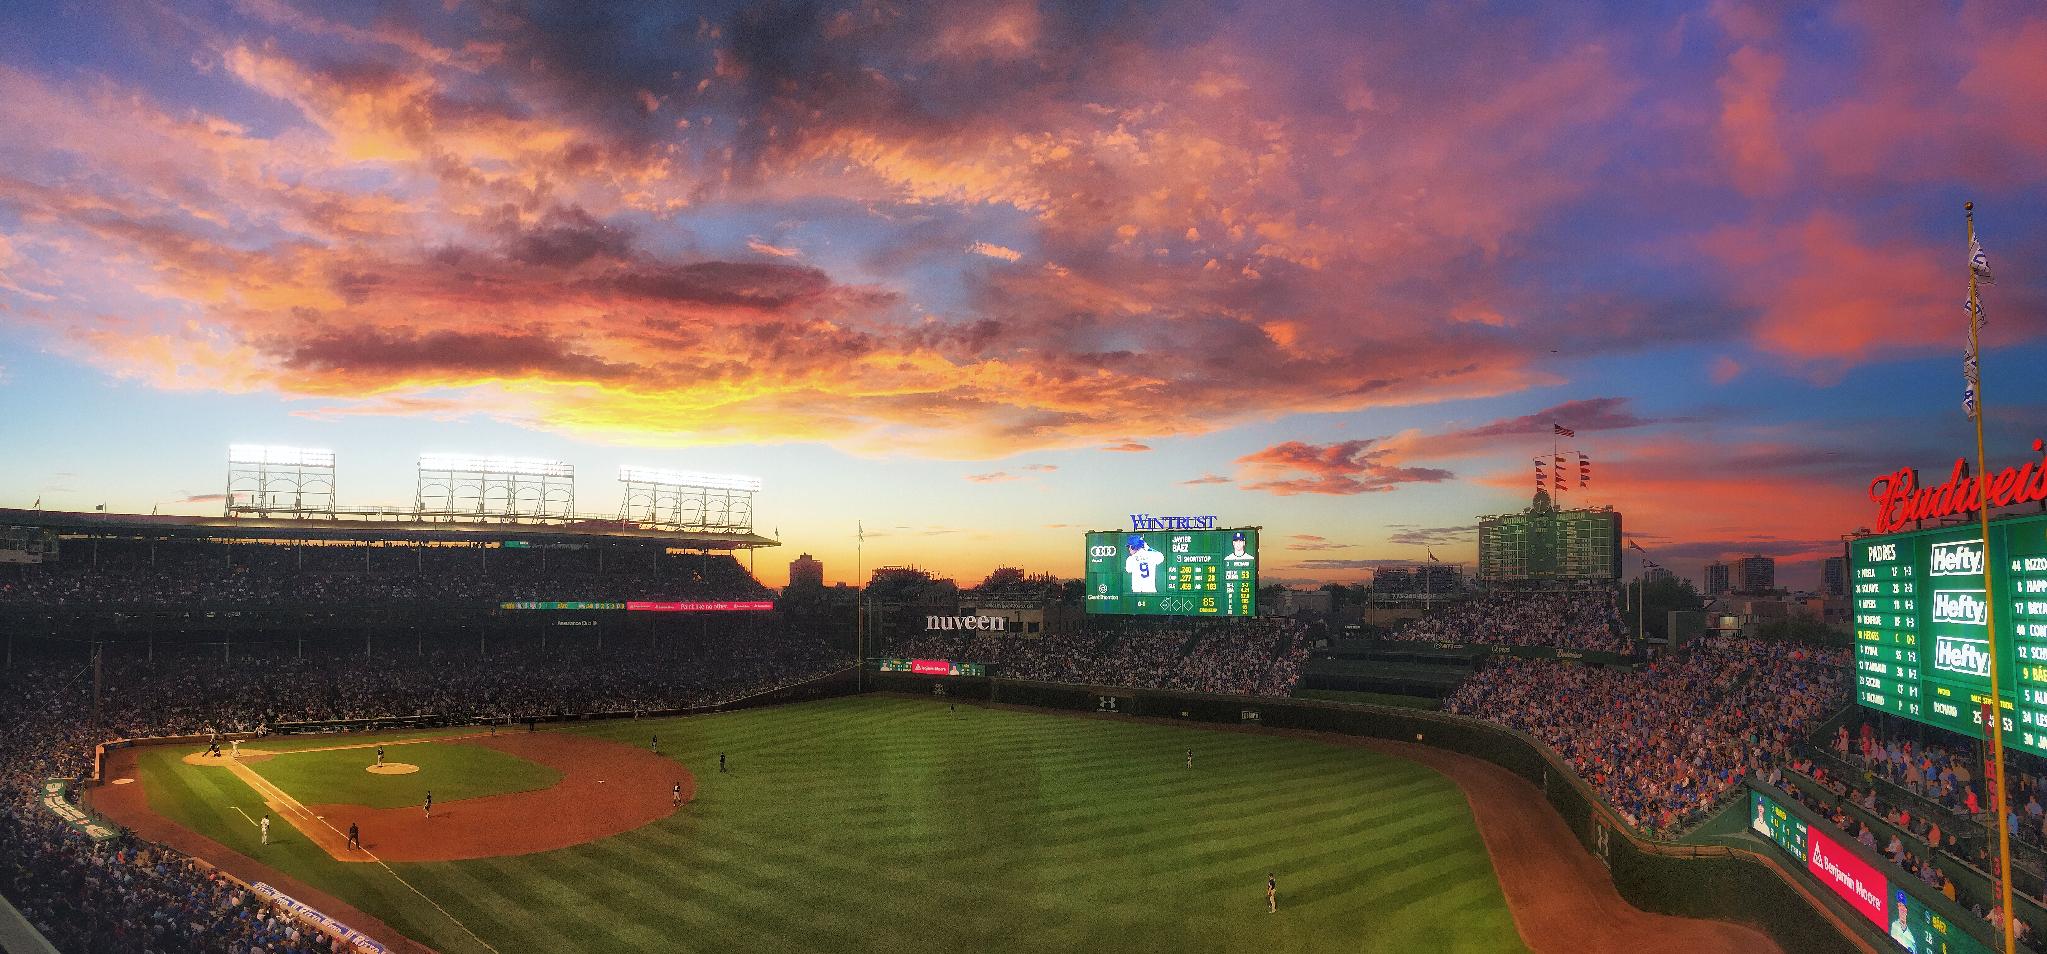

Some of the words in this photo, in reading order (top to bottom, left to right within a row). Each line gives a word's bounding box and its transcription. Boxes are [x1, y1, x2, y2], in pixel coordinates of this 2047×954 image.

[1130, 513, 1217, 530] WINTRUST
[1172, 543, 1189, 552] BÁEZ
[1868, 544, 1896, 562] PADRES
[1933, 546, 1981, 574] Hefty
[2011, 559, 2021, 571] 44
[1140, 562, 1149, 578] 9
[1202, 597, 1215, 607] 85
[1936, 594, 1985, 623] Hefty
[2015, 603, 2023, 614] 17
[926, 615, 1004, 631] nuveen
[1939, 640, 1989, 675] Hefty
[2018, 646, 2027, 658] 12
[2023, 667, 2029, 680] 9
[2024, 689, 2030, 702] 5
[2002, 717, 2013, 732] 53
[1824, 855, 1855, 892] Benjamin
[1856, 879, 1881, 911] Moore
